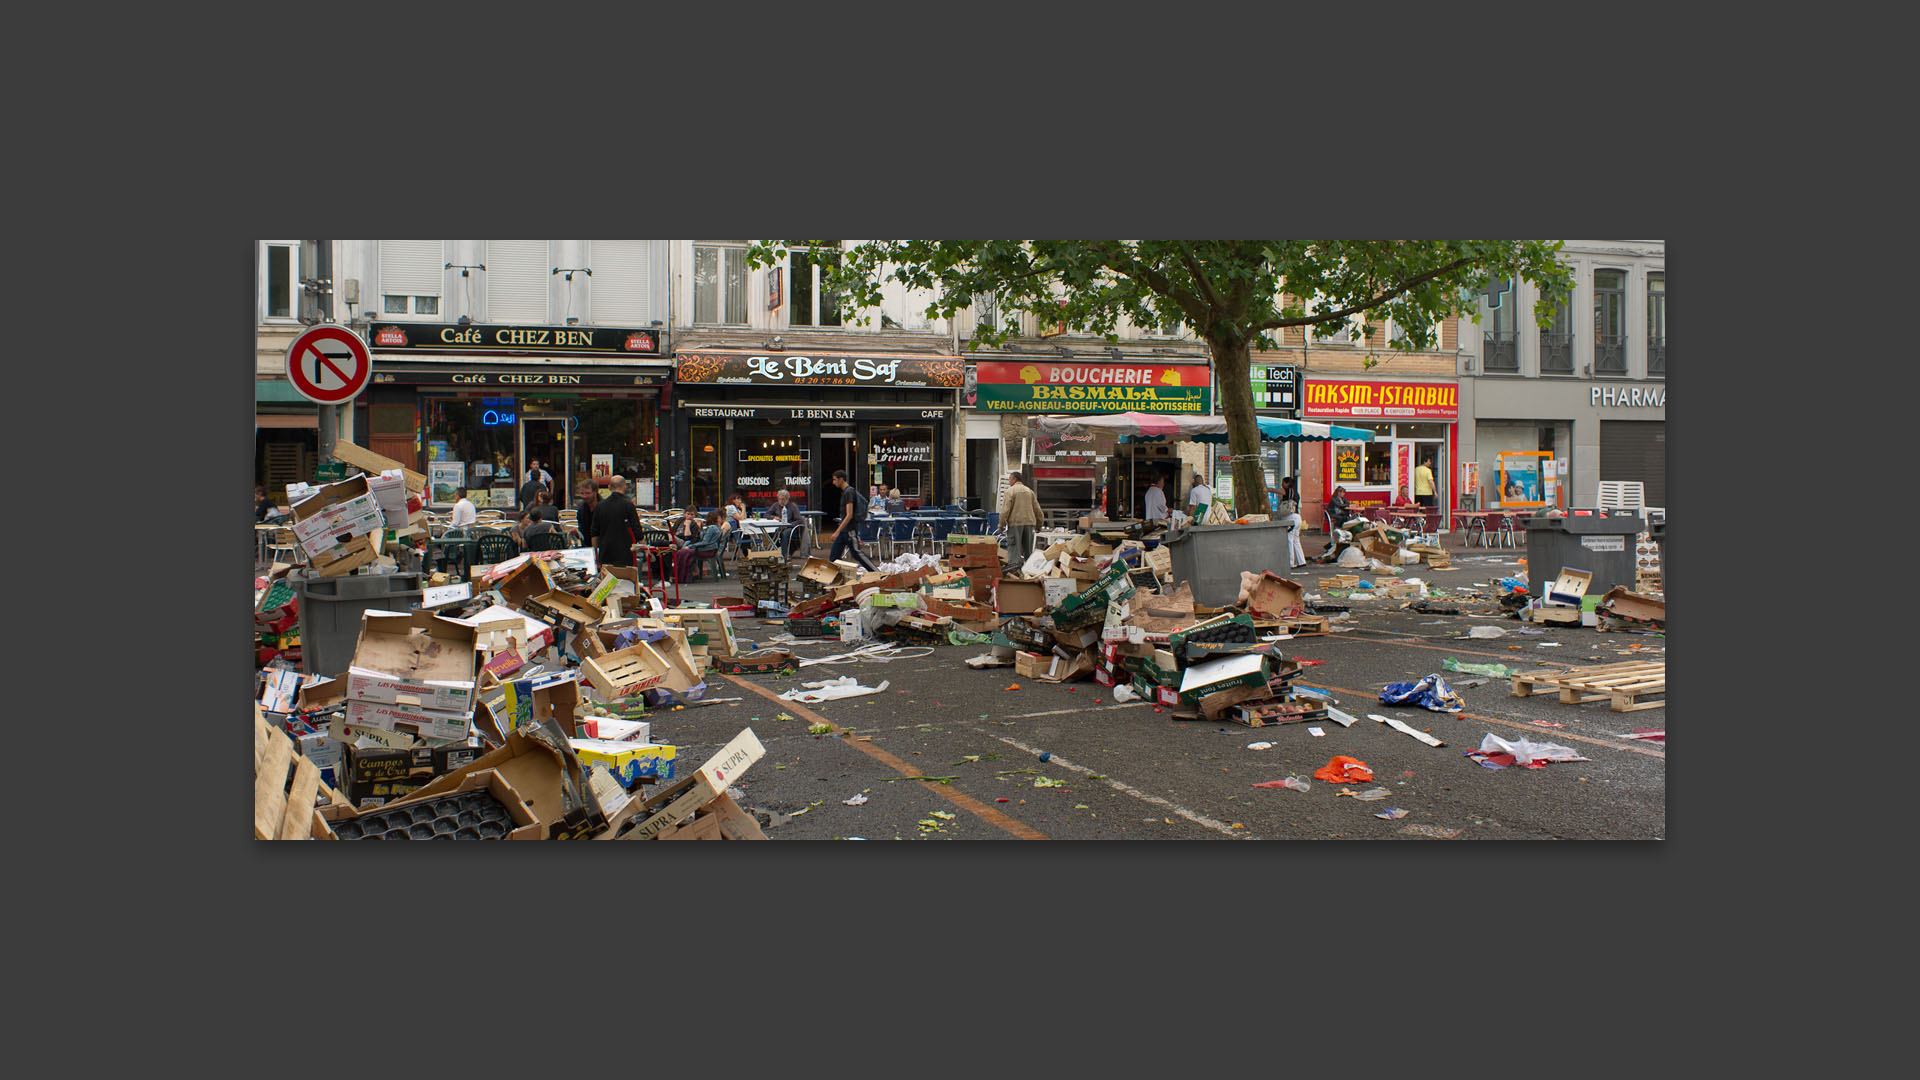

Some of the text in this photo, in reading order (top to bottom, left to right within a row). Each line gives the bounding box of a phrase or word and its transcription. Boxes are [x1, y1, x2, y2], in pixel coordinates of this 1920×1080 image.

[440, 327, 594, 346] Café CHEZ BEN
[746, 356, 902, 382] Le Béni Saf
[1267, 367, 1293, 380] Tech
[451, 374, 581, 384] Café CHEZ BEN
[1049, 368, 1153, 384] BOUCHERIE
[1032, 385, 1159, 400] BASMALA
[1307, 384, 1458, 406] TAKSIM-ISTANBUL
[986, 400, 1202, 411] VEAU-AGNEAU-BOEUF-VOLAILLE-ROTISSERIE
[695, 408, 755, 417] RESTAURANT
[791, 409, 856, 419] LE BENI SAF
[921, 410, 944, 418] CAFE
[873, 444, 930, 454] Restaurant
[880, 453, 923, 462] Oriental
[737, 476, 812, 486] COUSCOUS TAGINES
[1079, 575, 1112, 600] fruites font
[359, 759, 404, 769] Campos
[722, 748, 748, 773] SUPRA
[640, 812, 677, 838] SUPRA
